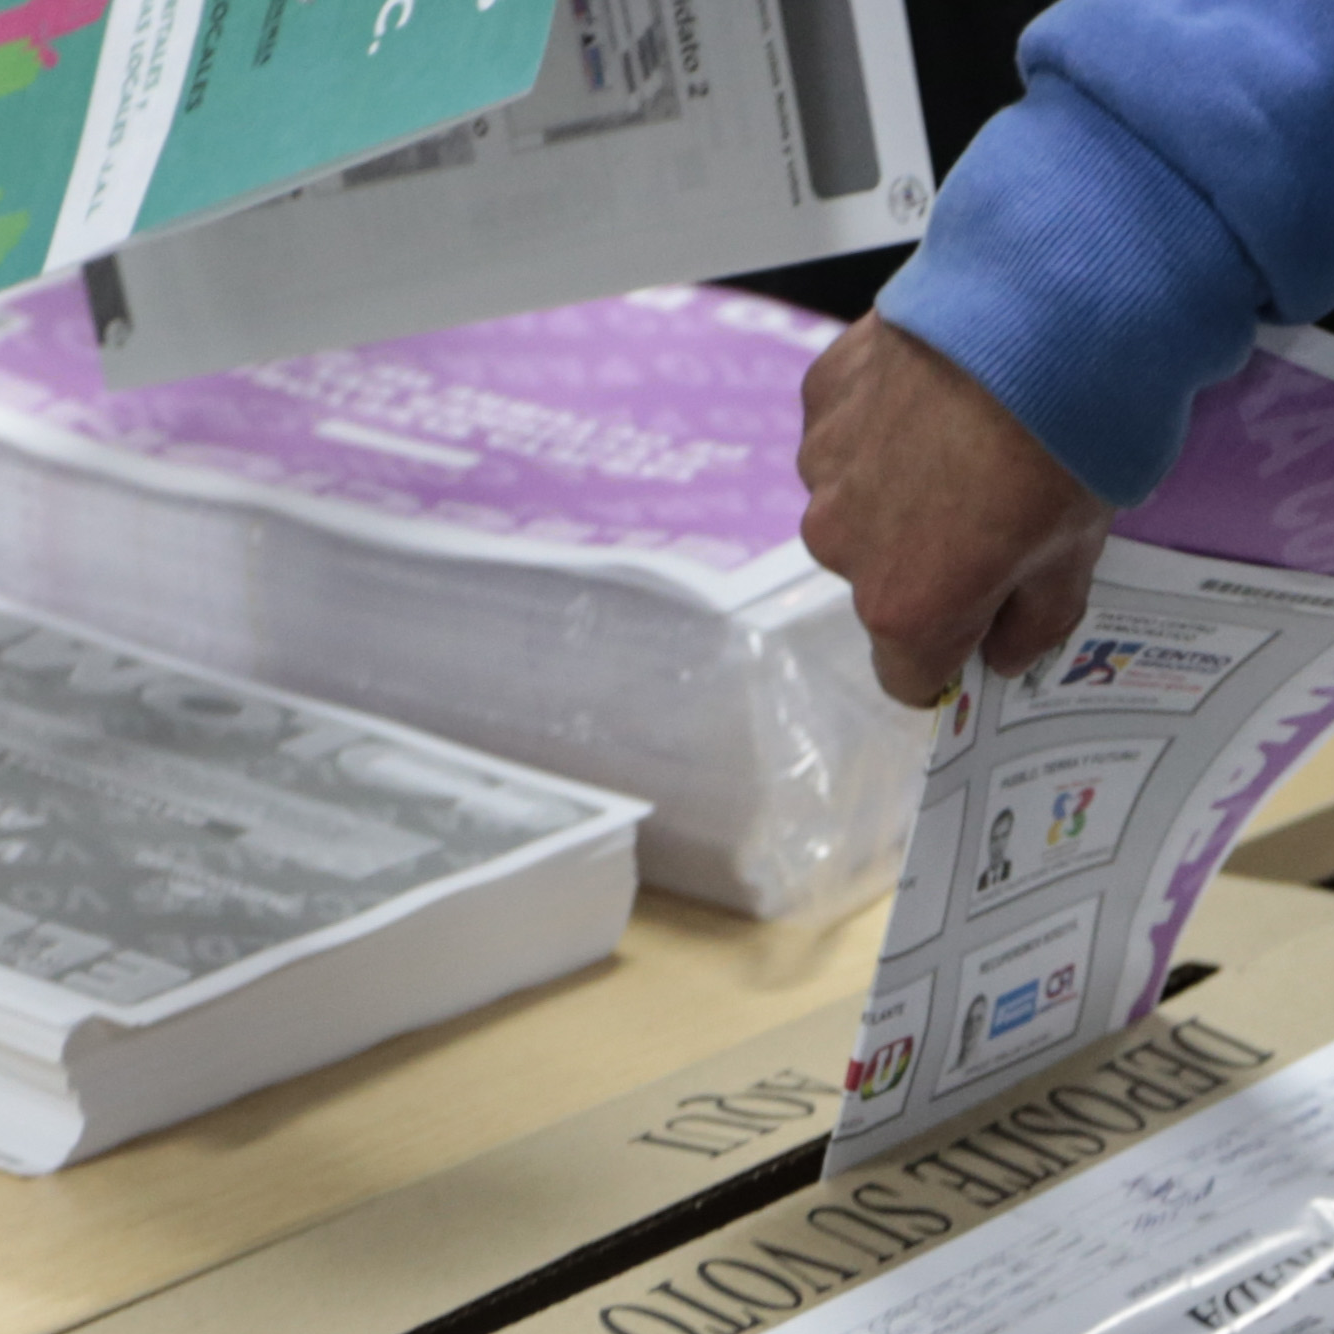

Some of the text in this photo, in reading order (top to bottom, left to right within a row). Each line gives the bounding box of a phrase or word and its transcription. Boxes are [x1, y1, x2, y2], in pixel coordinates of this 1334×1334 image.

[185, 0, 229, 114] OCALES
[1142, 646, 1234, 667] CENTRO
[631, 1069, 839, 1160] AQUI
[905, 1013, 1276, 1211] DEPOSITE
[809, 1180, 952, 1263] SU
